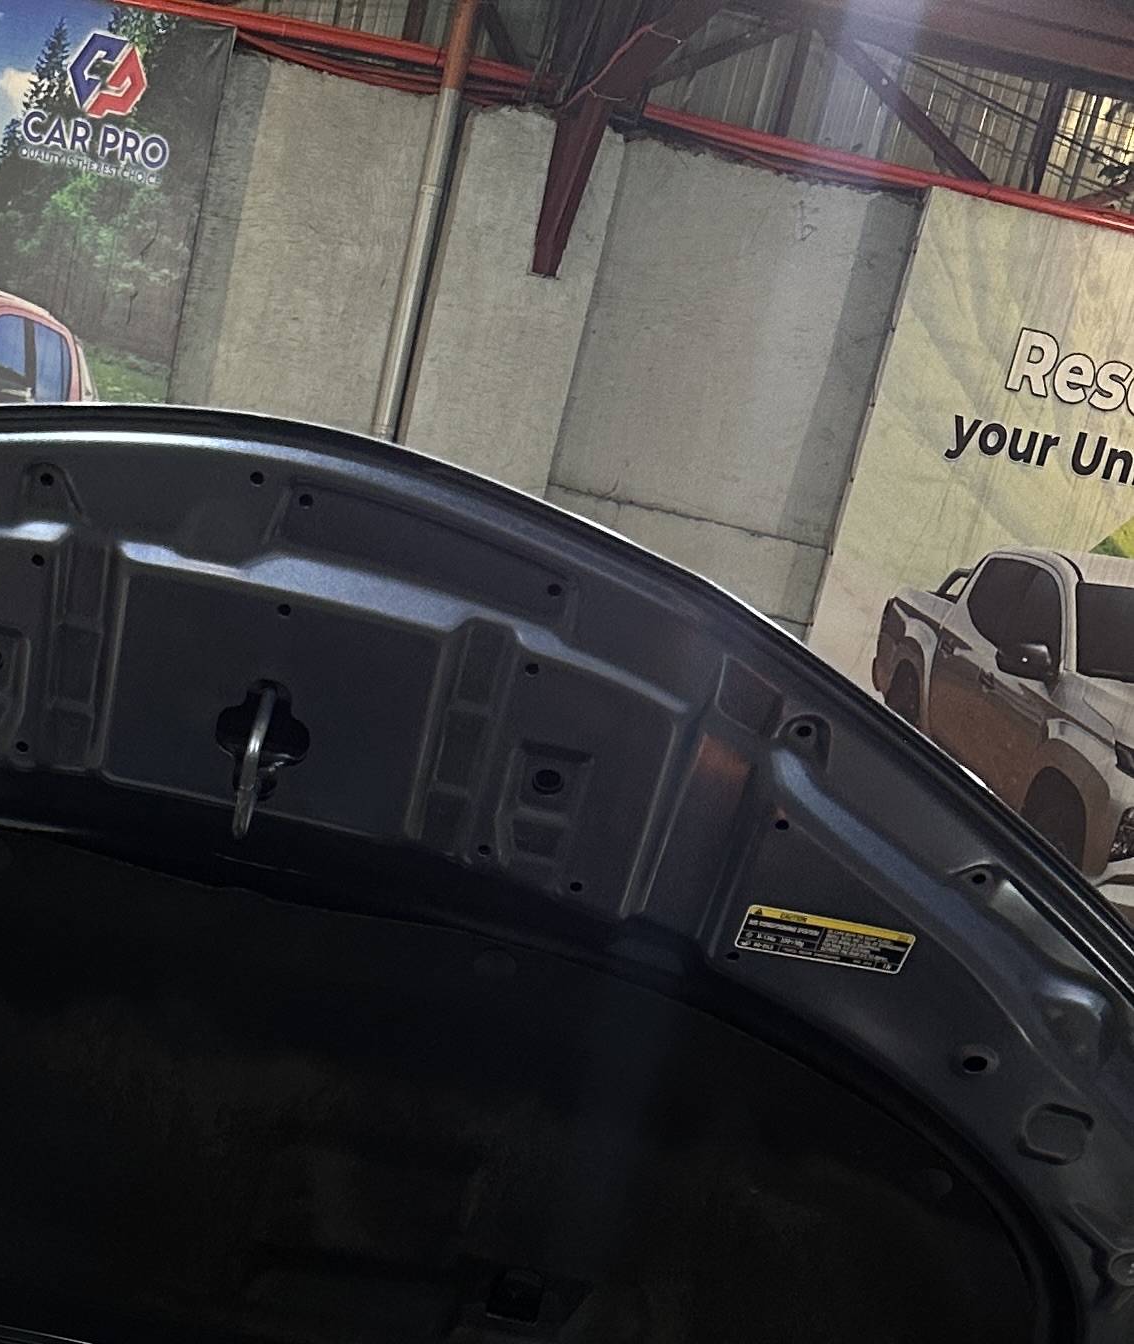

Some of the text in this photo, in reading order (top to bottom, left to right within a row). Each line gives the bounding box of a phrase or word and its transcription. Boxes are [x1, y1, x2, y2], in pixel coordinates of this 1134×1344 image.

[23, 110, 167, 169] CAR PRO
[1005, 327, 1134, 416] Res
[944, 415, 1134, 485] your Un
